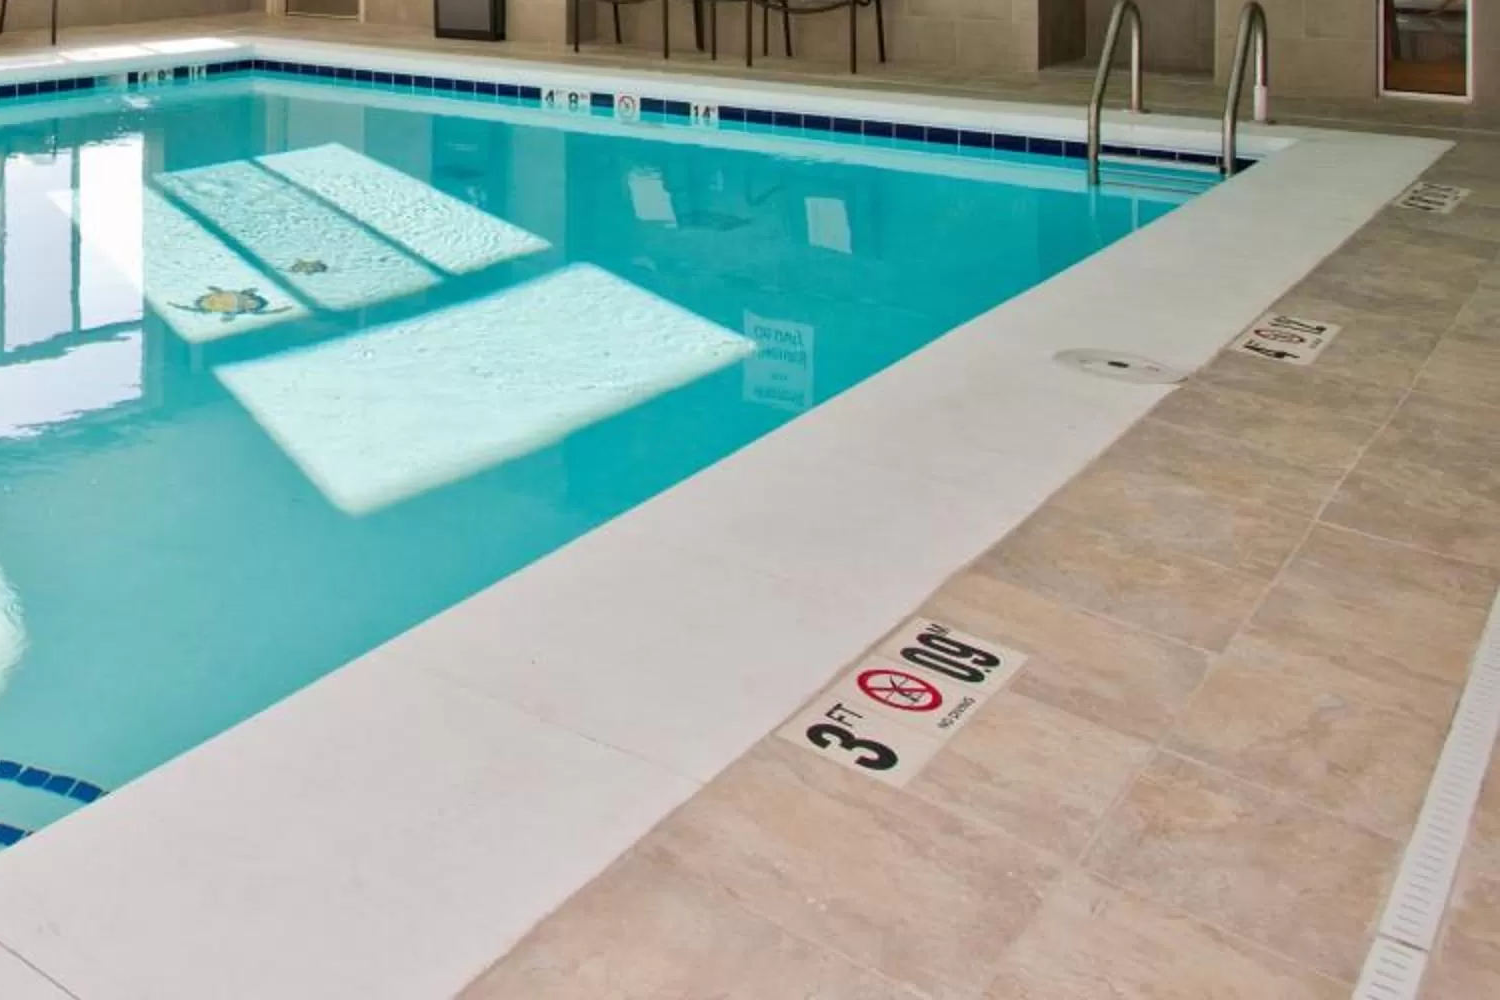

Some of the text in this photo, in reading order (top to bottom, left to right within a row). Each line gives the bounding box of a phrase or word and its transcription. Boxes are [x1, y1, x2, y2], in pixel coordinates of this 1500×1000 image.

[899, 632, 1001, 684] 0.9
[806, 702, 899, 771] 3 FT
